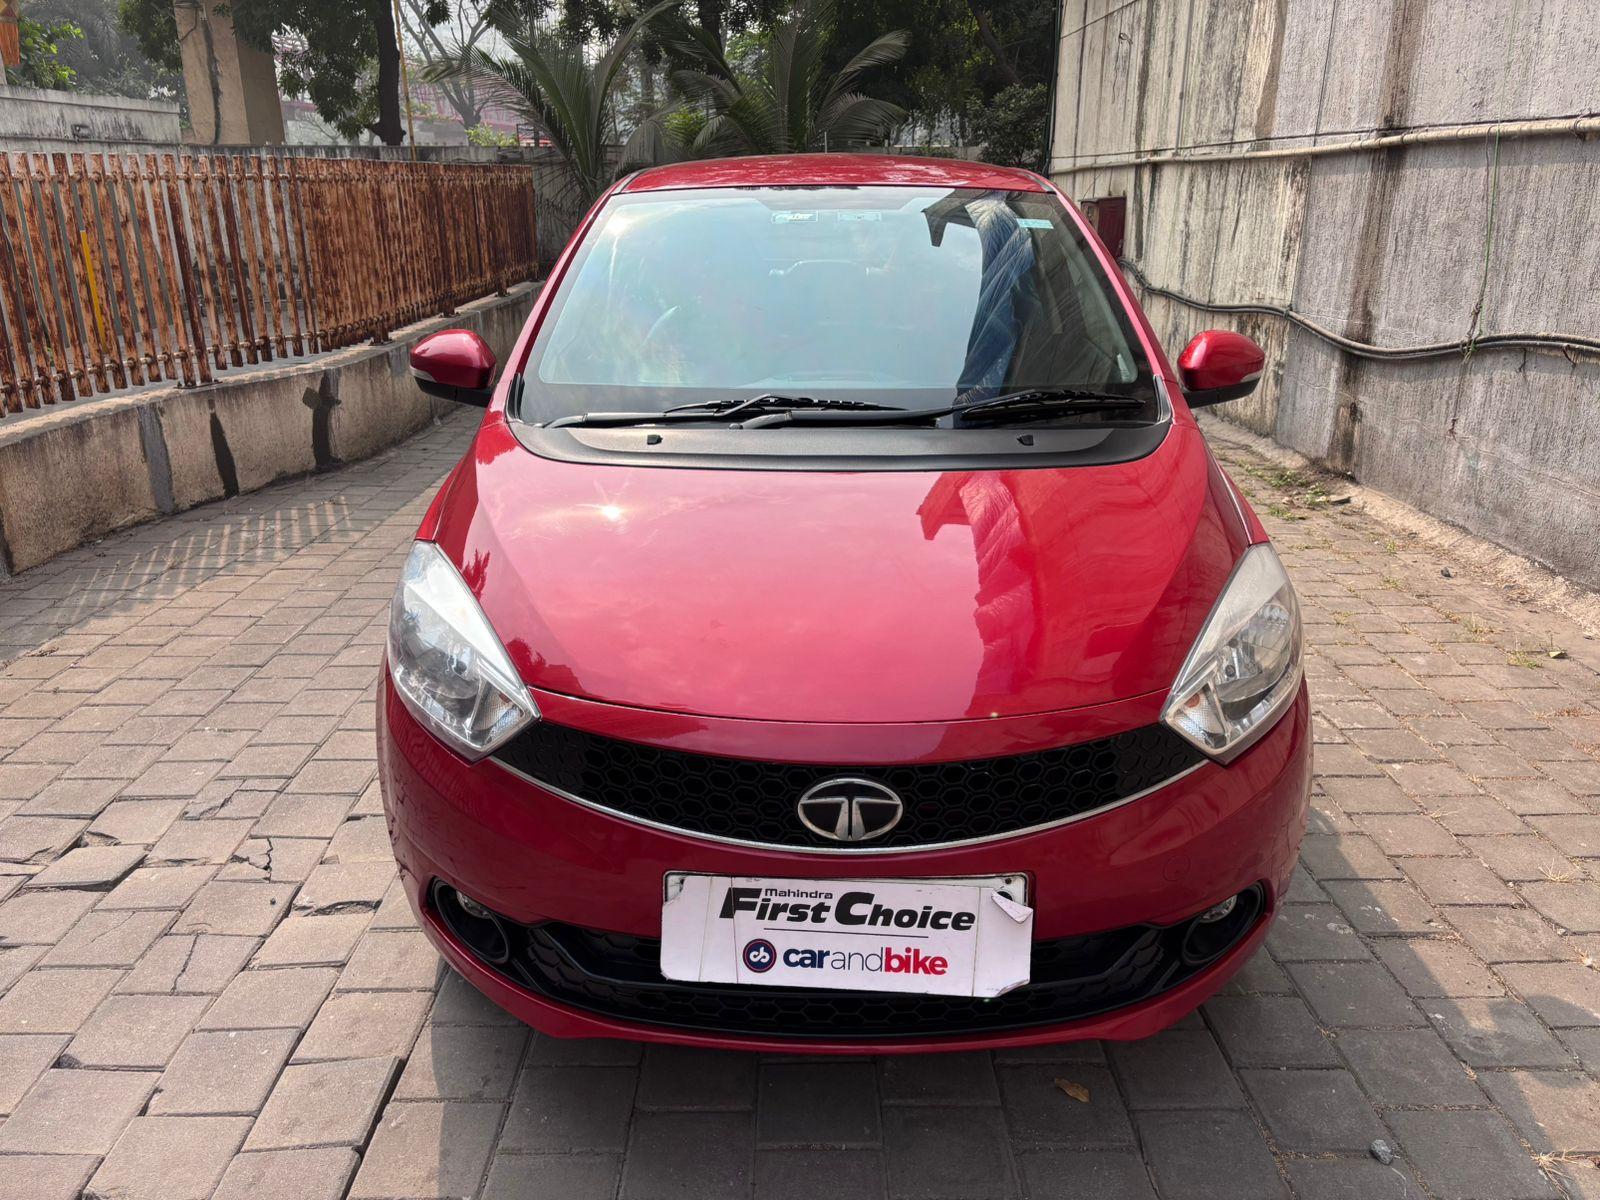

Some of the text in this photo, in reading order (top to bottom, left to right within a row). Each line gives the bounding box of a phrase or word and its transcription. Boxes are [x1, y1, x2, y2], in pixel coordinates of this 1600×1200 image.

[719, 887, 976, 931] First Choice
[783, 946, 948, 975] carandbike
